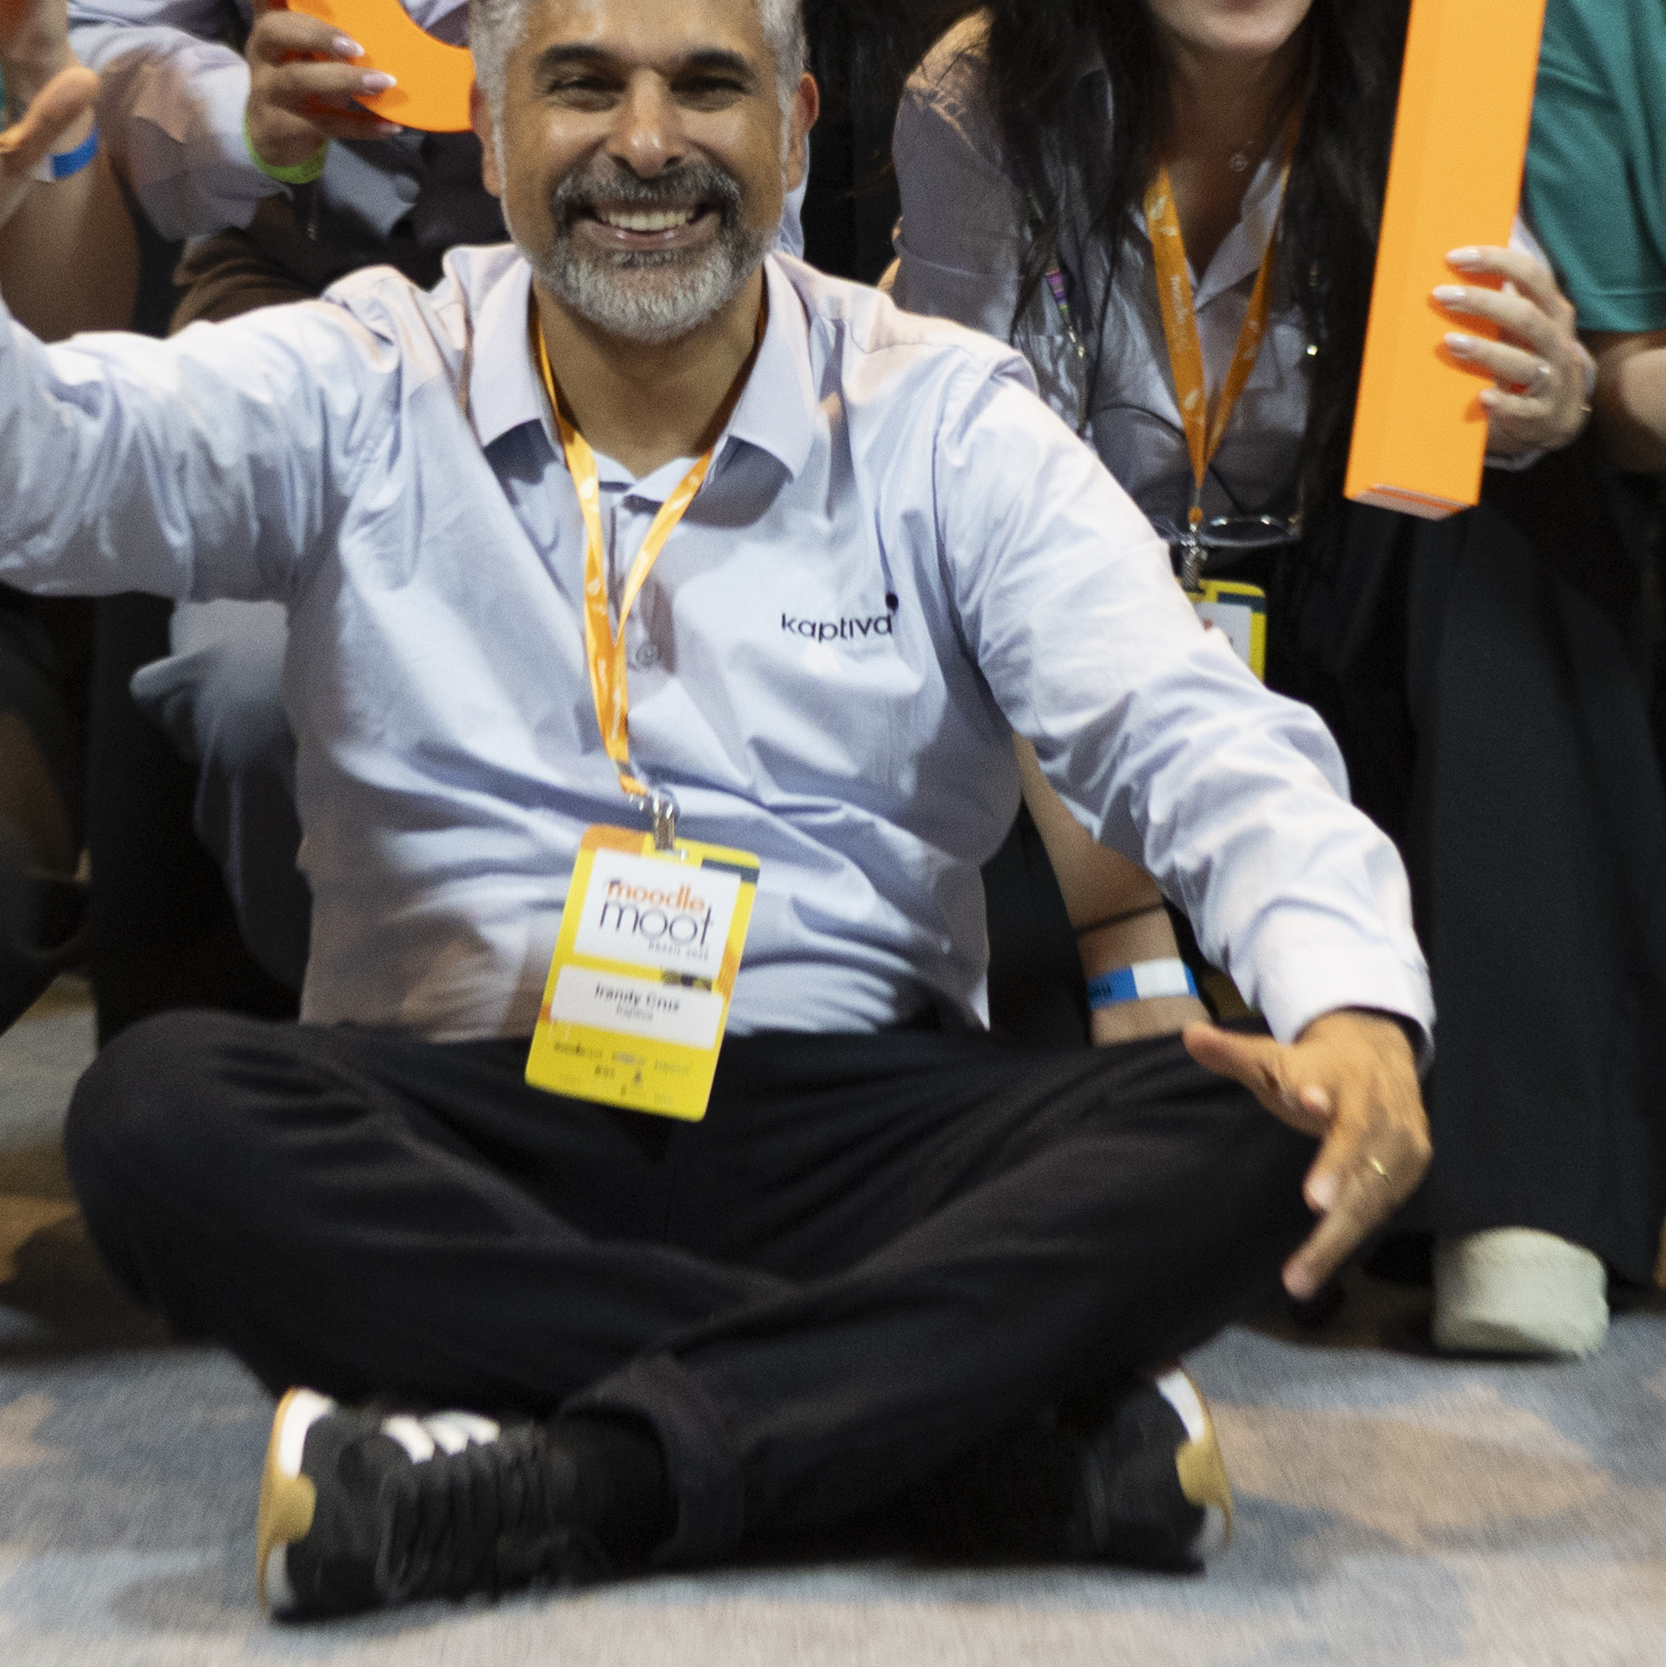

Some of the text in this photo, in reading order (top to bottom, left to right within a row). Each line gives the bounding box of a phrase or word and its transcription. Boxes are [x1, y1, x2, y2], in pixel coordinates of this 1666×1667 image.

[781, 611, 893, 644] kaptiva
[606, 879, 706, 914] moodle
[598, 900, 714, 948] moot
